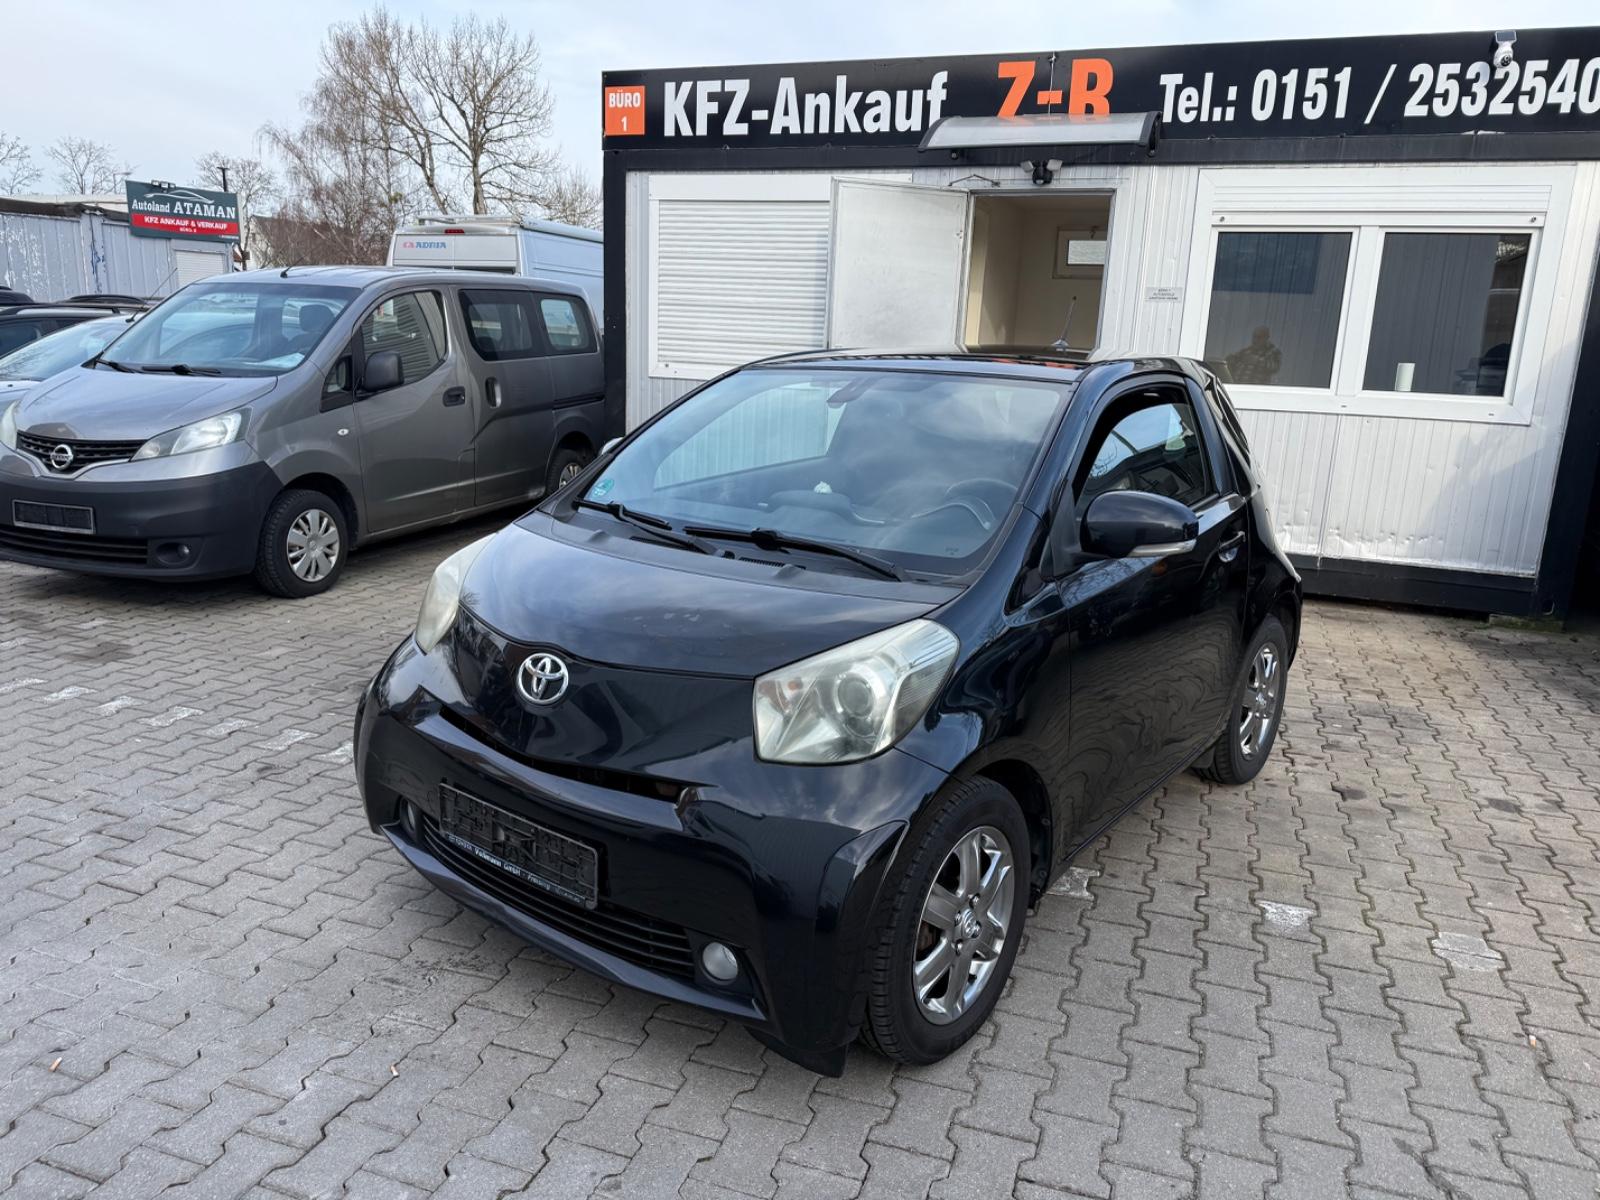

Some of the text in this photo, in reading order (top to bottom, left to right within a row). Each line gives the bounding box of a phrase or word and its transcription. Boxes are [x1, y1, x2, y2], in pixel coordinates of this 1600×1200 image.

[609, 89, 641, 108] BÜRO
[1159, 57, 1600, 124] Tel.: 0151 / 2532540
[664, 70, 949, 137] KFZ-Ankauf
[621, 116, 628, 132] 1
[131, 199, 236, 219] Autoland ATAMAN
[144, 216, 159, 224] KFZ
[159, 218, 189, 227] ANKAUF
[197, 221, 228, 230] VERKAUF
